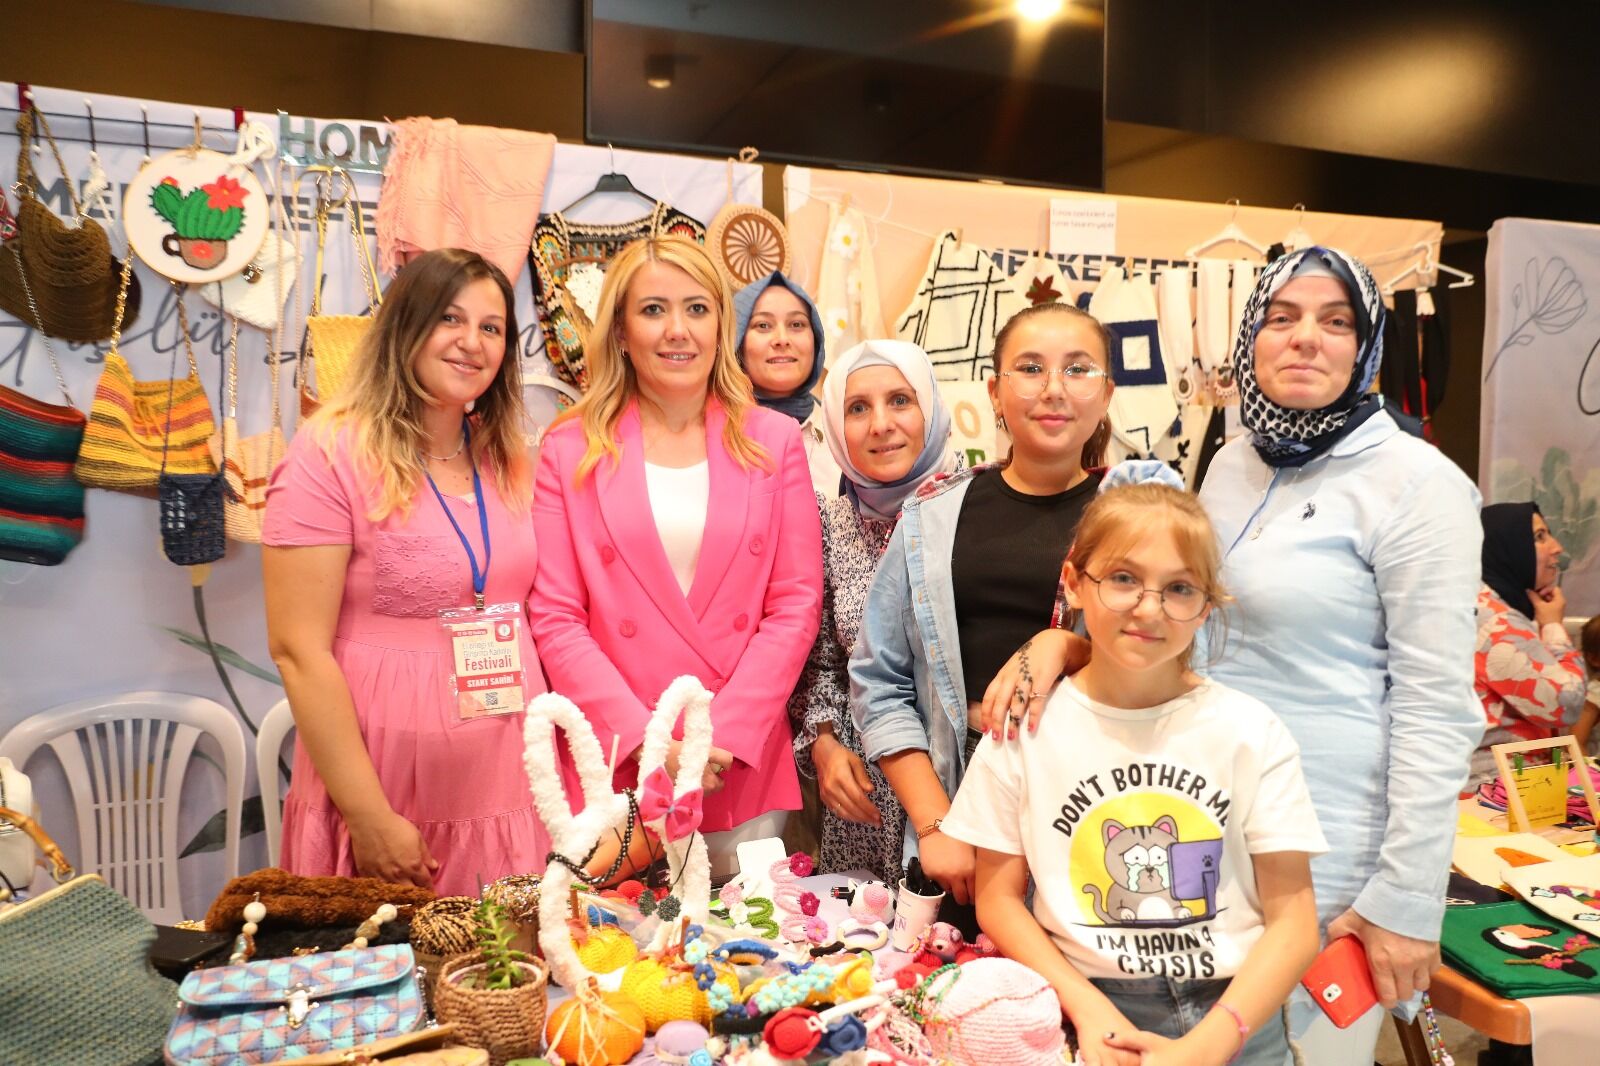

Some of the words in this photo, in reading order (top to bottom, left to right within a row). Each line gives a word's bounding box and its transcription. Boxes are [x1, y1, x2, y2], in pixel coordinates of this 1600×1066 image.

[279, 112, 393, 163] HOM
[465, 655, 512, 671] Festivali
[1052, 774, 1105, 837] DON'T
[1111, 763, 1206, 800] BOTHER
[1096, 933, 1128, 953] I'M
[1134, 932, 1201, 956] HAVIN
[1117, 950, 1216, 979] CRISIS
